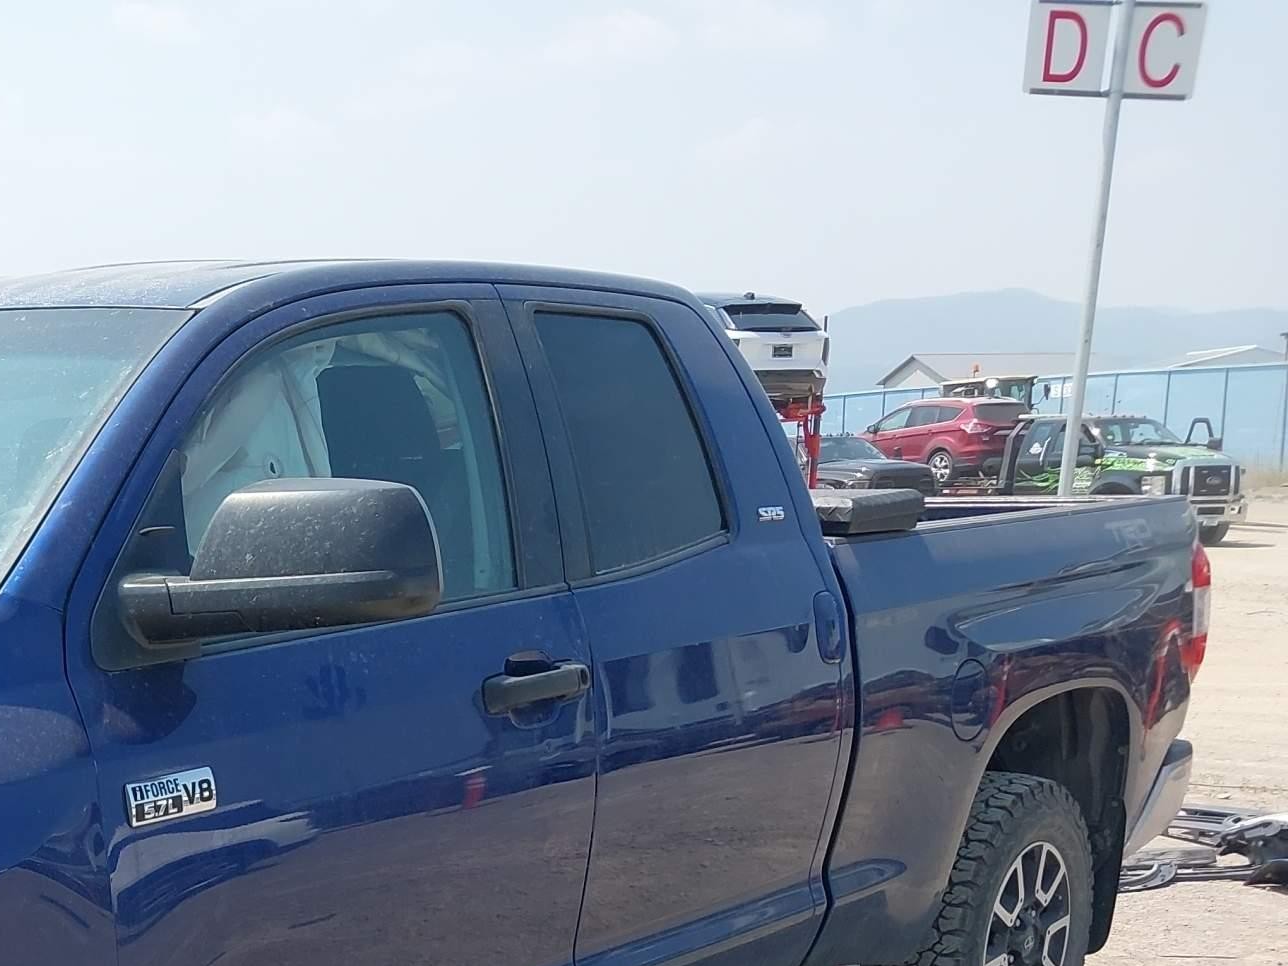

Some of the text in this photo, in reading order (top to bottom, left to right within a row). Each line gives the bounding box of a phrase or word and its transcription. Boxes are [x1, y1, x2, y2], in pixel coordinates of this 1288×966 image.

[1042, 10, 1088, 83] D
[1138, 12, 1185, 88] C
[758, 506, 785, 521] SR5
[182, 778, 213, 805] V8
[143, 798, 178, 819] 5.7L
